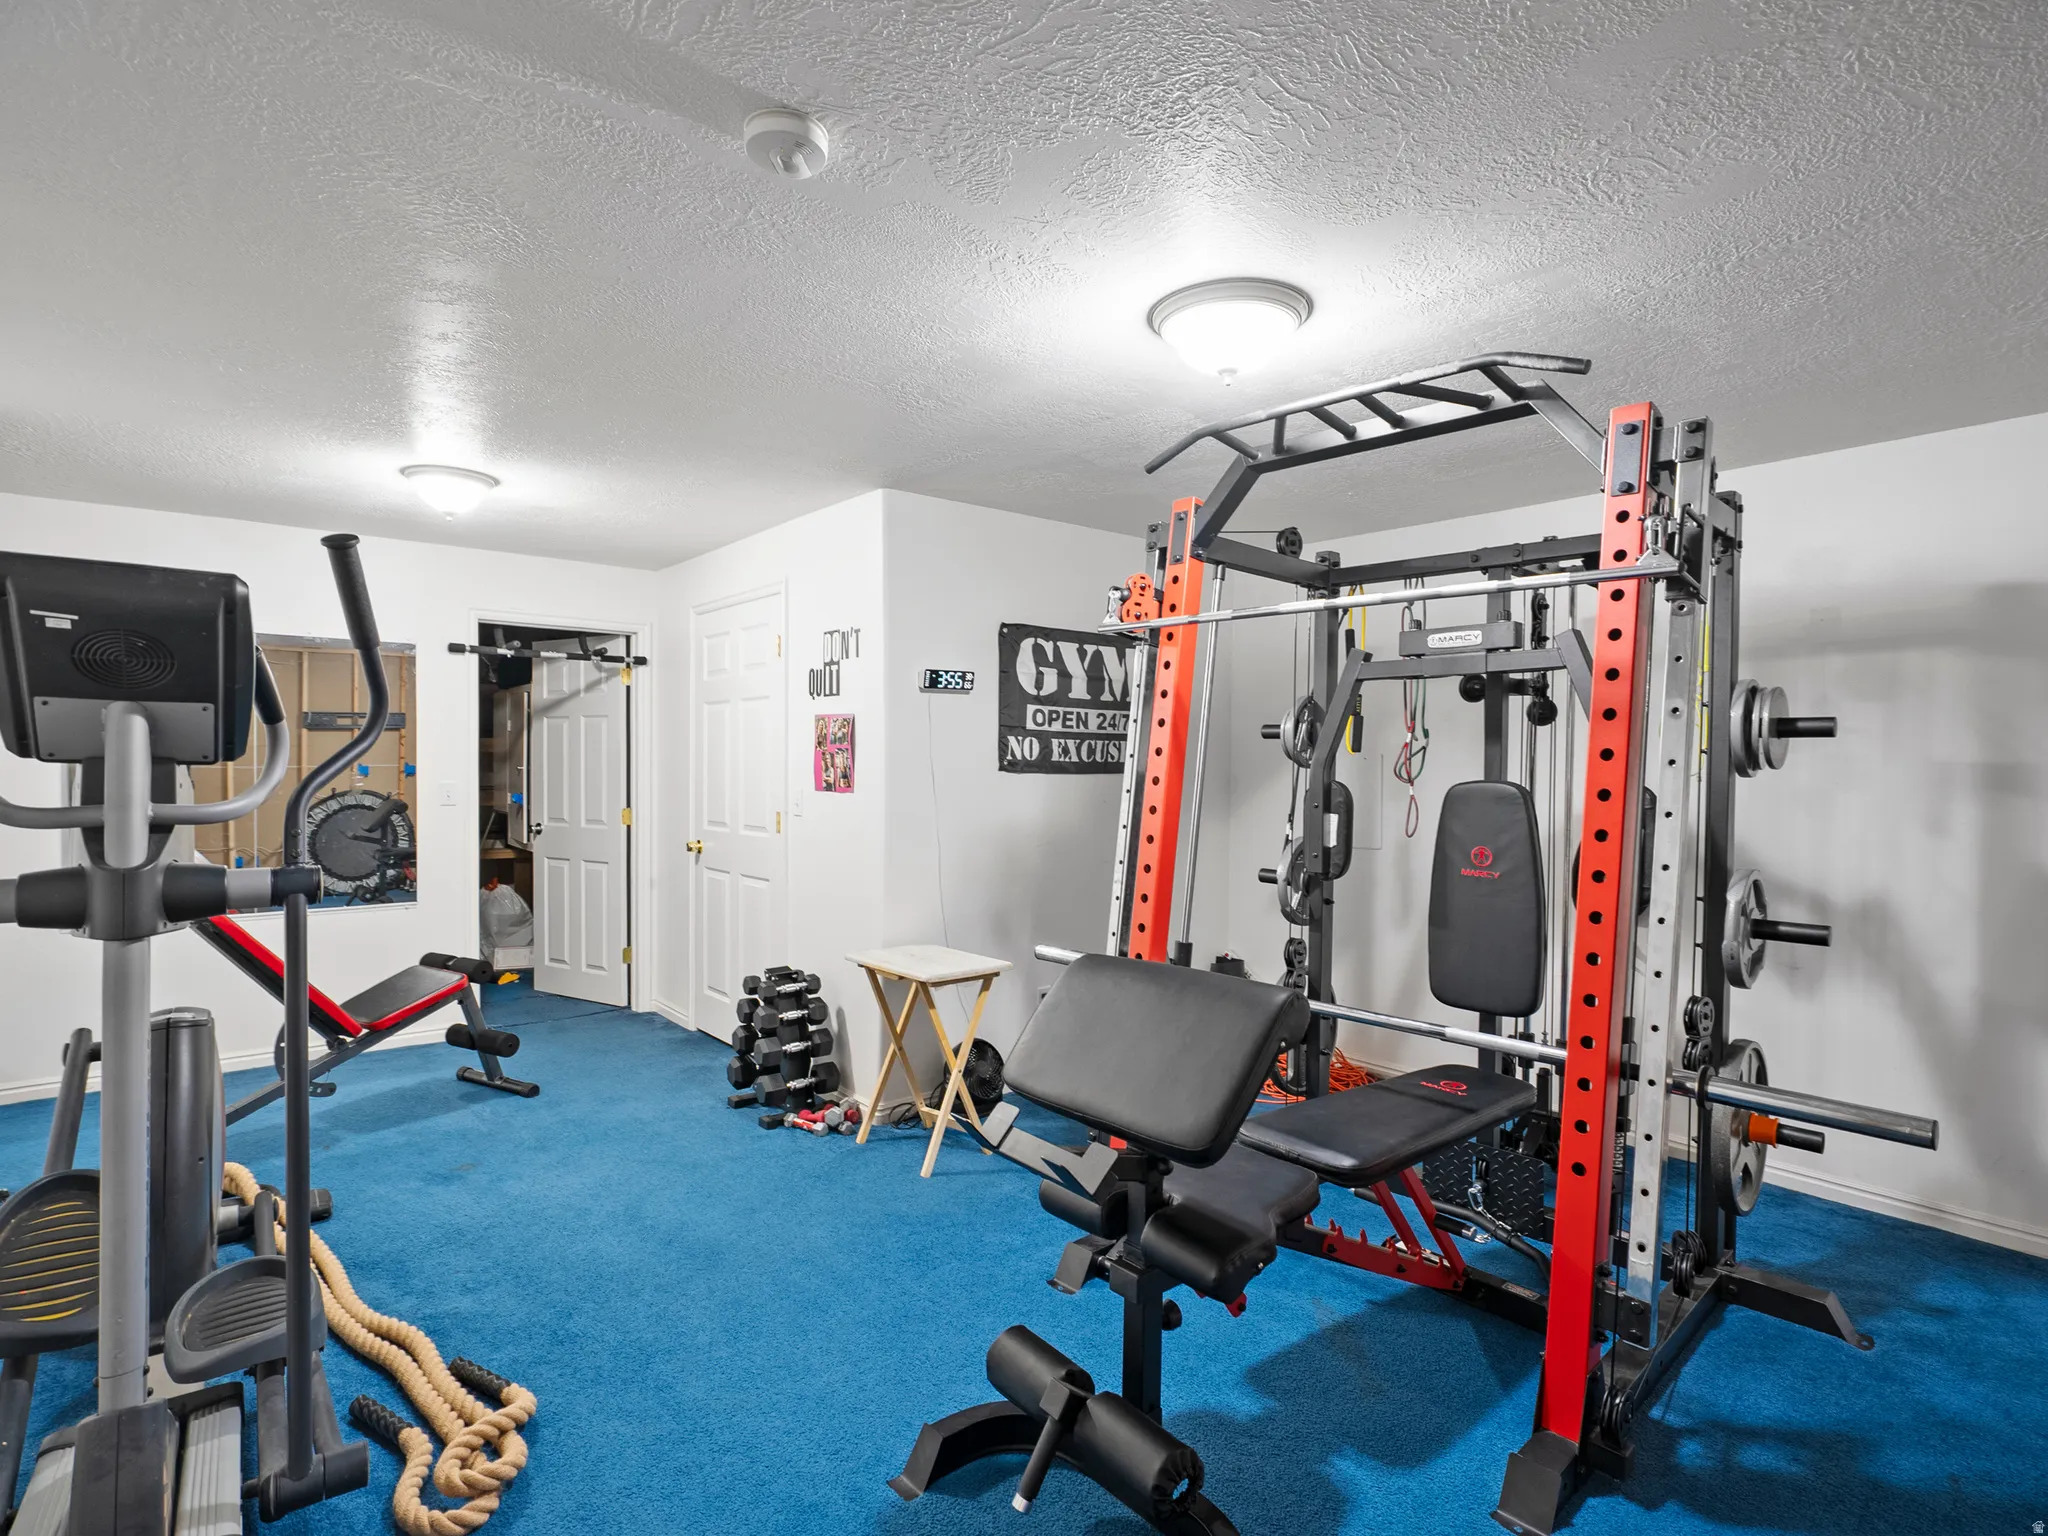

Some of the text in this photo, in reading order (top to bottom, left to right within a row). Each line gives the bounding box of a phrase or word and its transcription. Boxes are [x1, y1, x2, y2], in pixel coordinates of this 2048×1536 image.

[823, 626, 861, 663] DON'T
[1438, 633, 1480, 643] MARCY
[937, 671, 962, 689] 3:55
[1016, 637, 1135, 702] GYM
[808, 665, 840, 700] QUIT
[1032, 708, 1131, 732] OPEN 24/7
[1006, 736, 1040, 761] NO
[1460, 868, 1500, 878] MARCY
